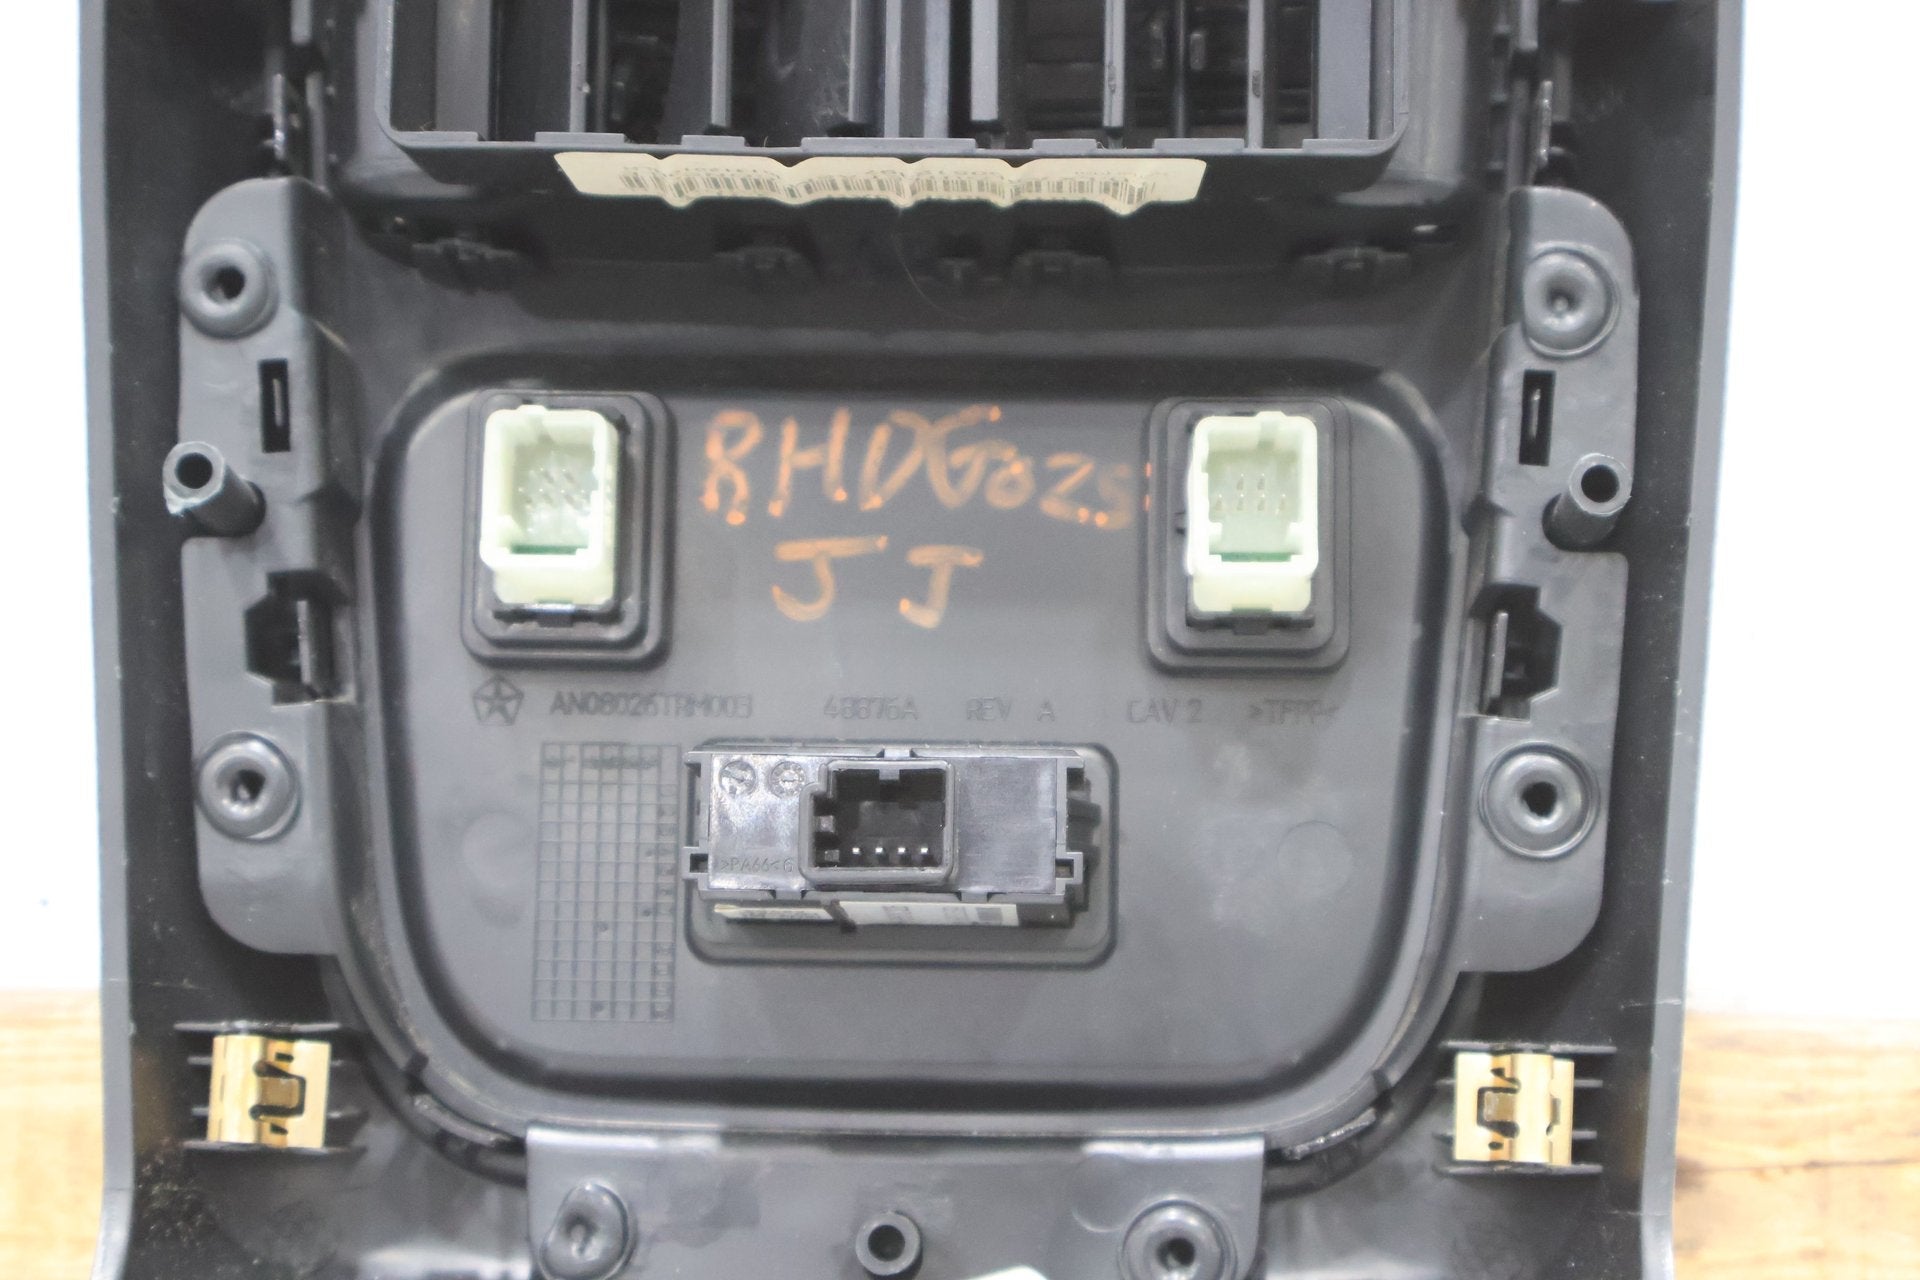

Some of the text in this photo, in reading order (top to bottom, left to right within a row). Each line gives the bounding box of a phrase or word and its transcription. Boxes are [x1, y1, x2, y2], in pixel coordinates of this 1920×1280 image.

[966, 695, 1013, 722] REV
[1036, 698, 1056, 723] A
[1126, 697, 1179, 724] CAV
[1187, 697, 1204, 724] 2
